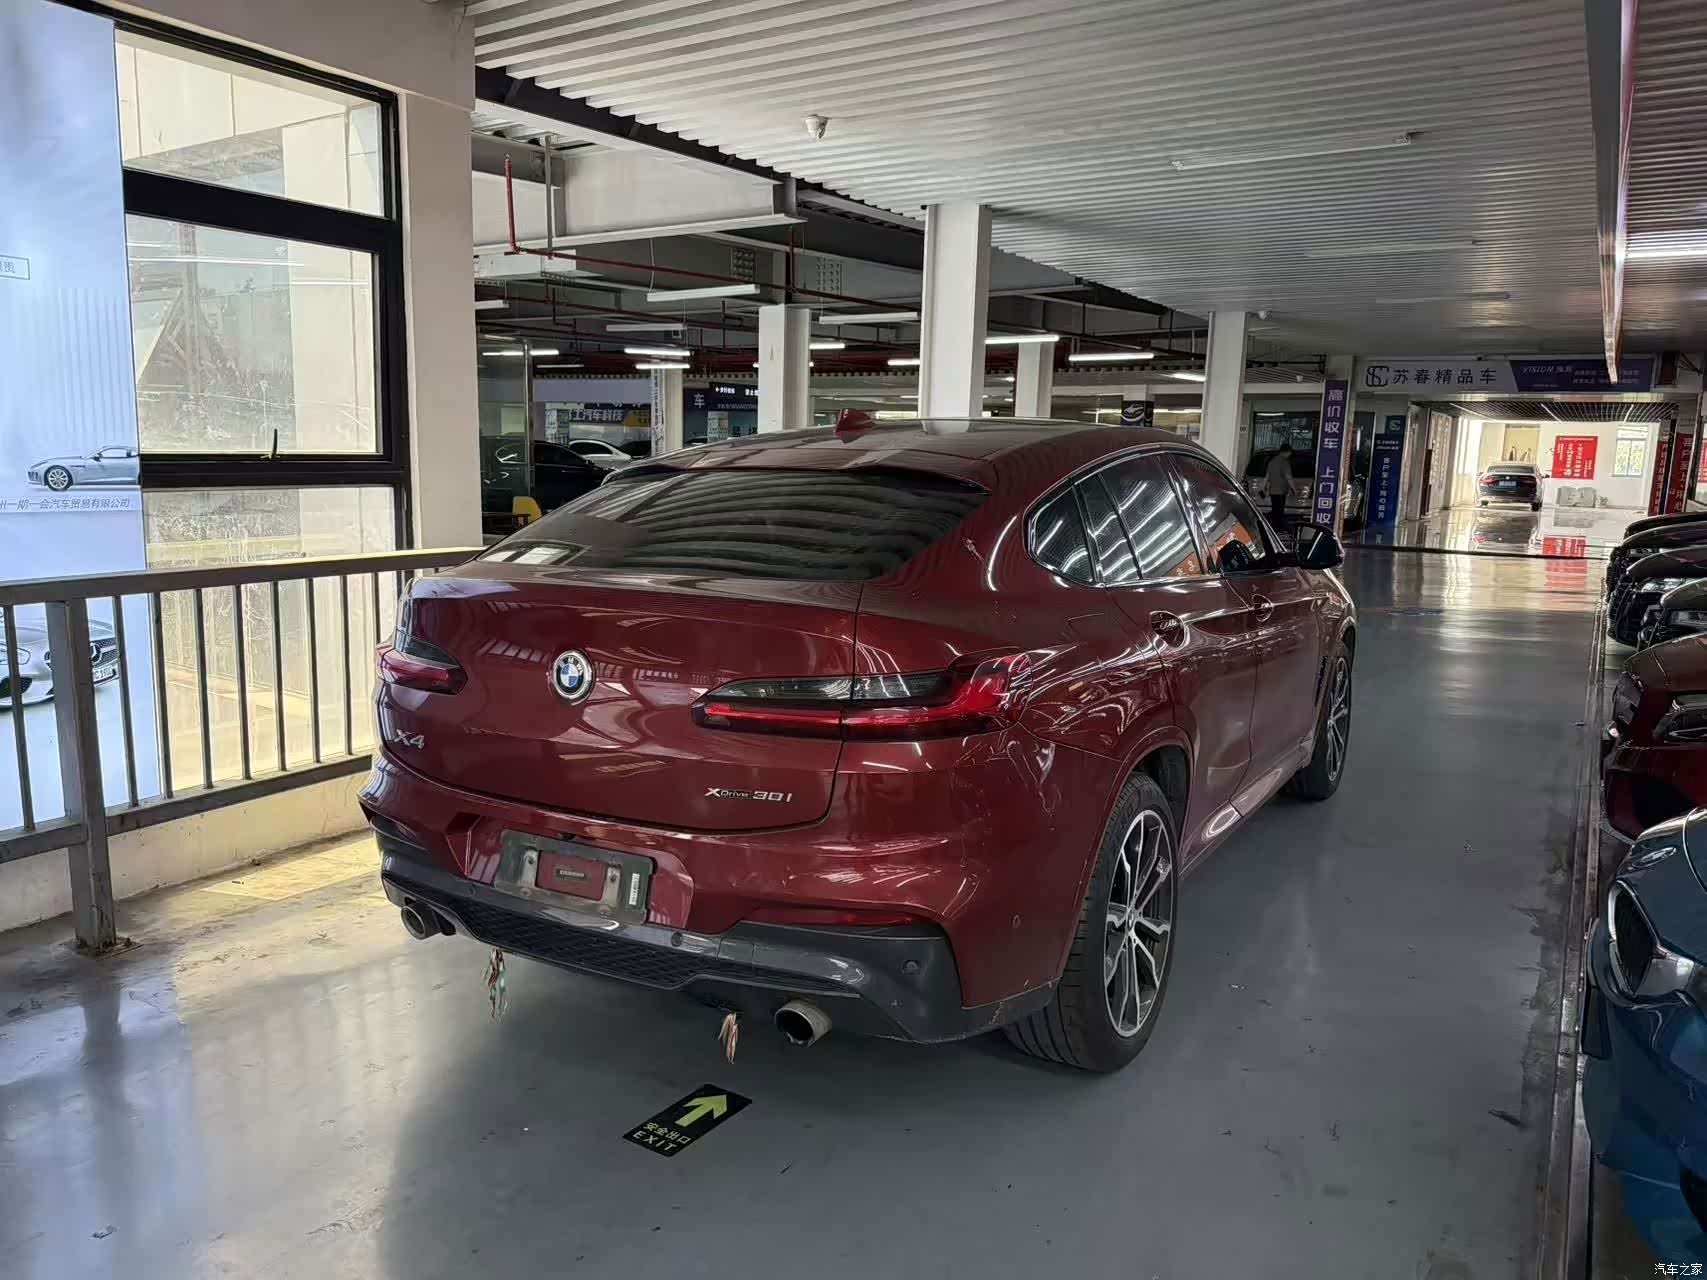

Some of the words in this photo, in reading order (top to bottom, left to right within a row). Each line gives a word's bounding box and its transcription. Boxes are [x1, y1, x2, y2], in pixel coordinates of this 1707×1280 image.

[1392, 368, 1497, 385] 苏春精品车
[1323, 389, 1344, 449] 高价收车
[1316, 465, 1336, 524] 上门回收
[393, 729, 425, 749] X4
[632, 1130, 678, 1151] EXIT
[643, 1121, 691, 1145] 安全出口
